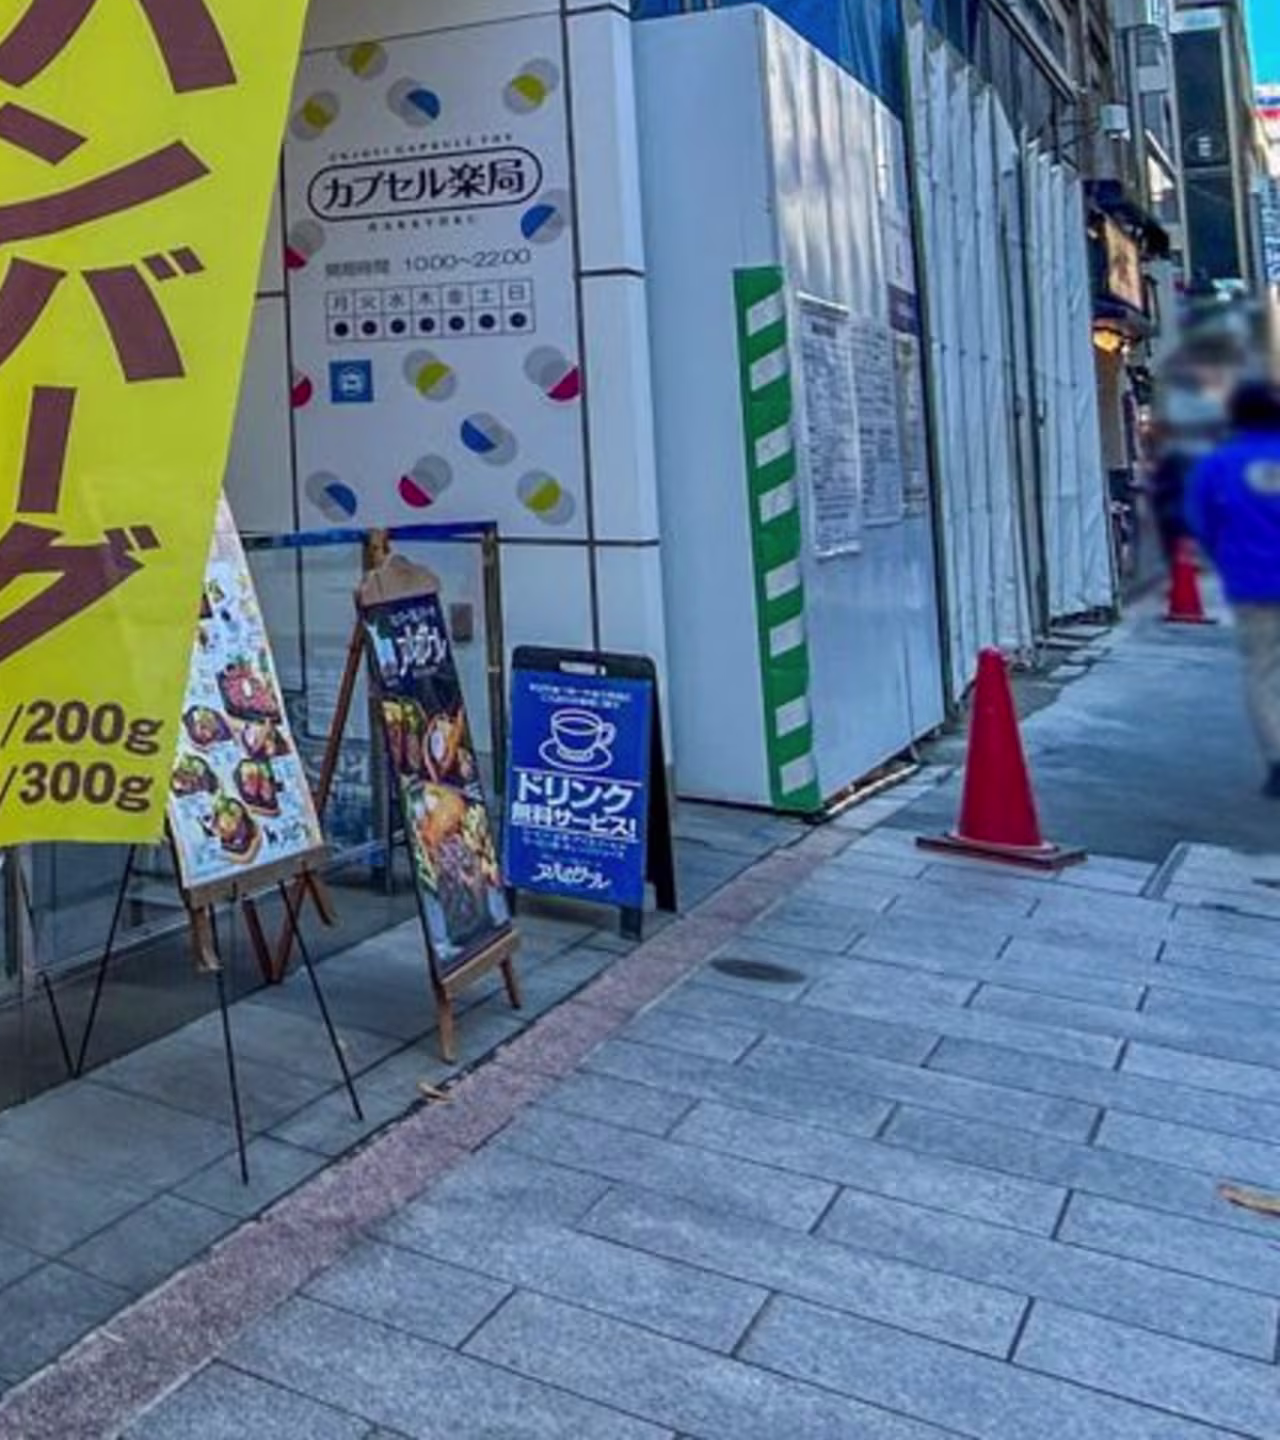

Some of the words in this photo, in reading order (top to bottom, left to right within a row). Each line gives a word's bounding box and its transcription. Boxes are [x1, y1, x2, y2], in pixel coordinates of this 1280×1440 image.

[322, 158, 526, 211] カプセル楽局
[517, 772, 634, 814] ドリンク
